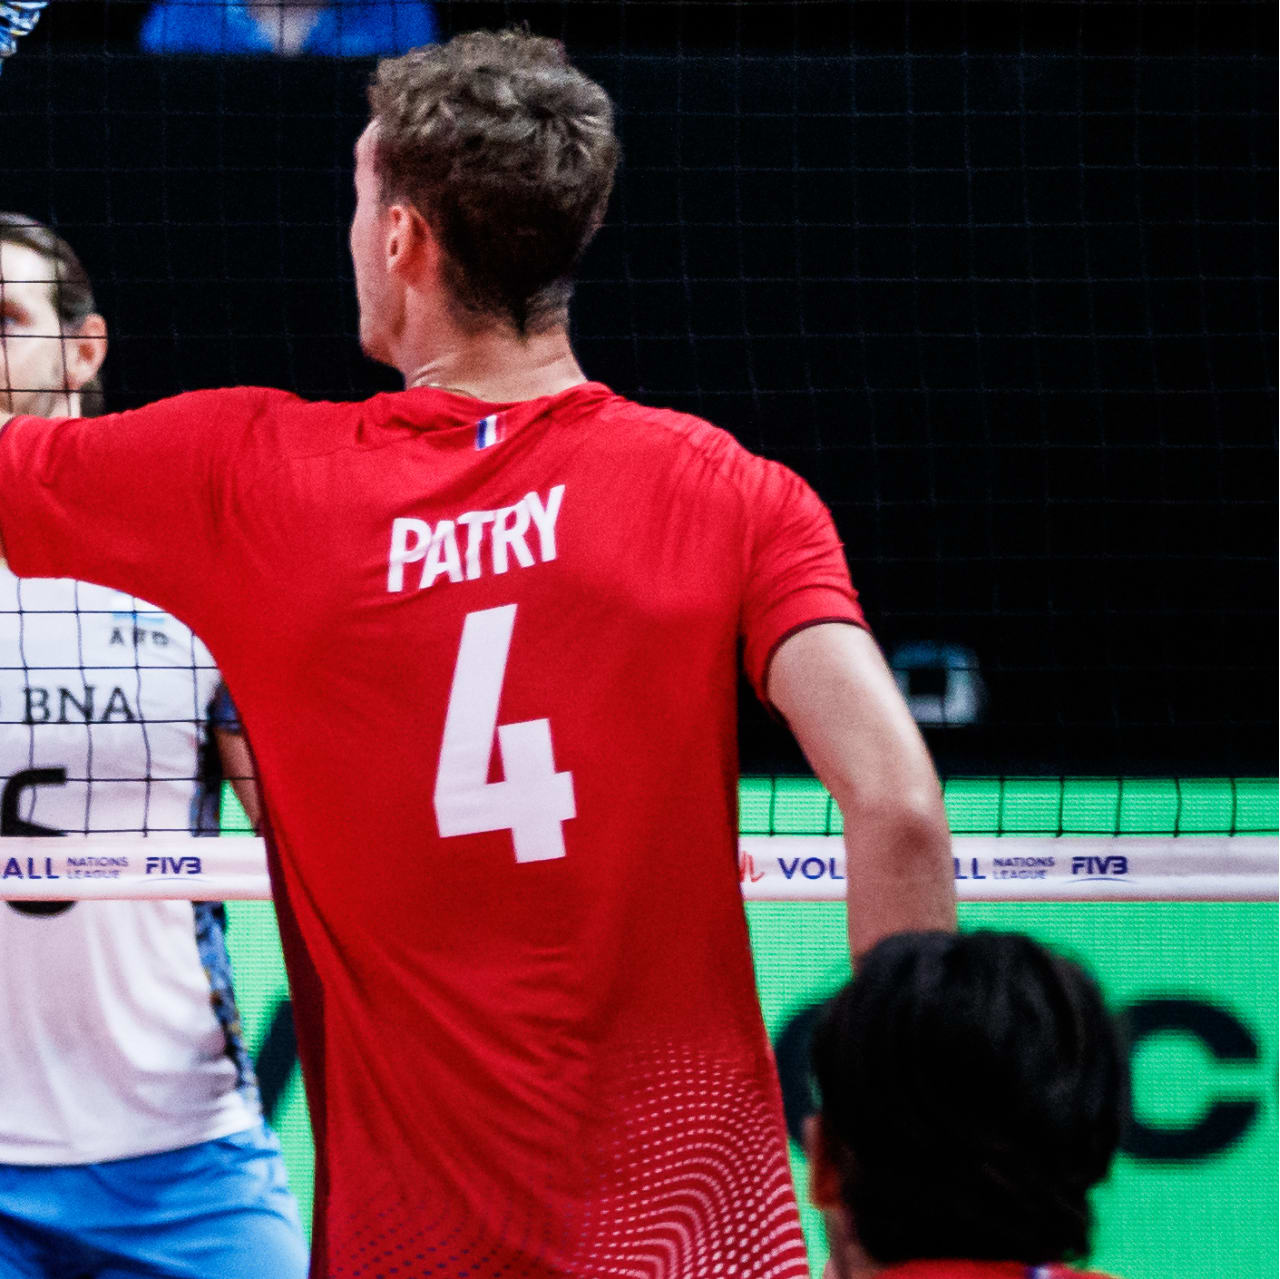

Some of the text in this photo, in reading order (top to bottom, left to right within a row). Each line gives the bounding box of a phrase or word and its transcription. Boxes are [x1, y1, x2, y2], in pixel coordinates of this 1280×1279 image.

[386, 484, 566, 594] PATRY
[23, 685, 137, 723] BNA
[433, 603, 577, 864] 4
